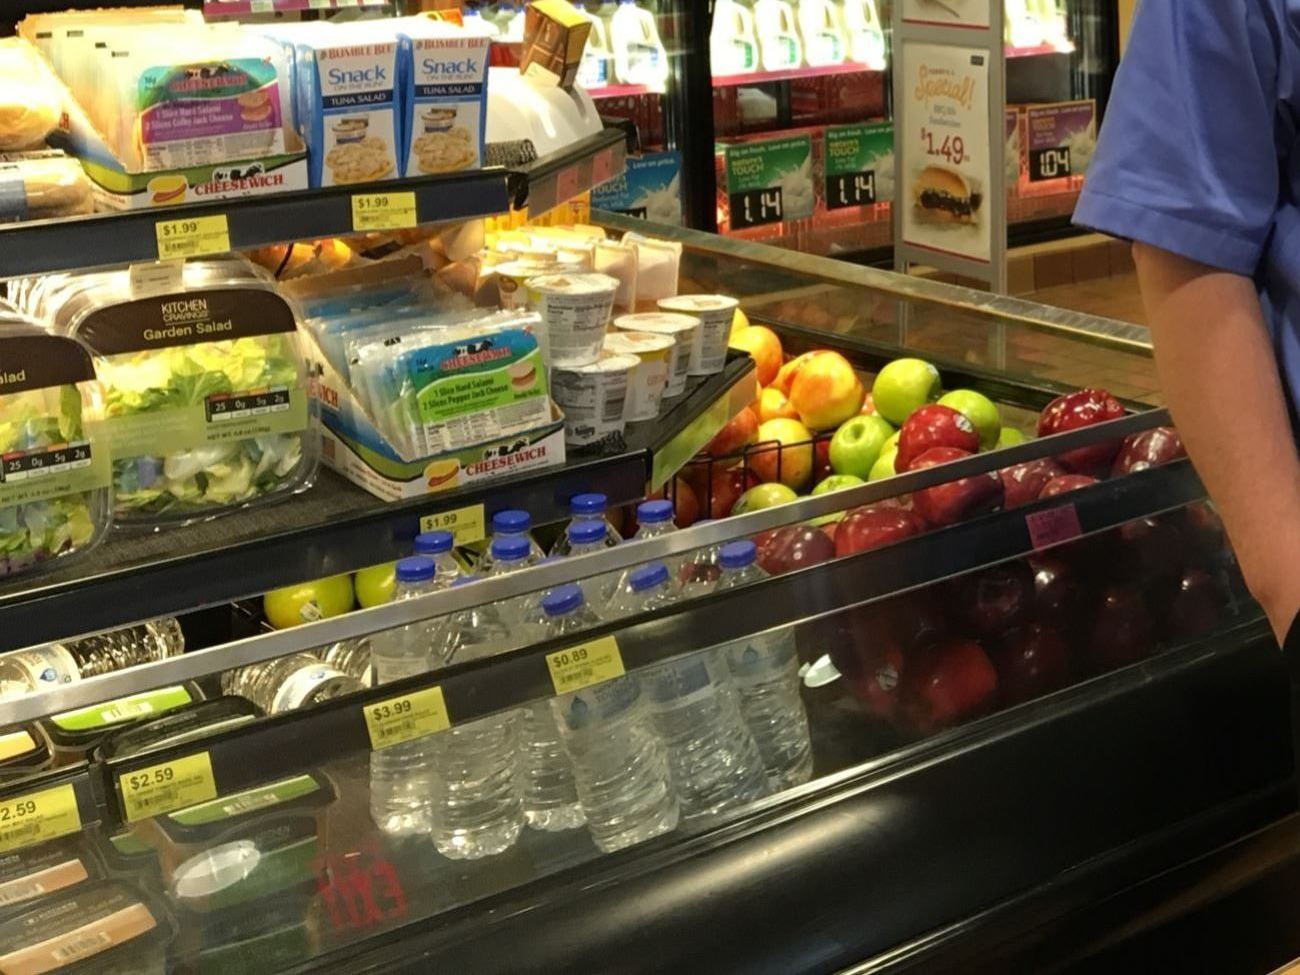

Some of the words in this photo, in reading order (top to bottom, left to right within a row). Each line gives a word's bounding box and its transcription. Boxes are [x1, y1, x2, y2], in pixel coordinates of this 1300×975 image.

[422, 58, 477, 75] Snack
[328, 65, 386, 85] Snack
[423, 86, 447, 95] TUNA
[448, 85, 475, 94] SALAD
[331, 95, 355, 106] TUNA
[357, 92, 386, 104] SALAD
[830, 146, 859, 157] TOUCH
[732, 163, 764, 175] TOUCH
[195, 174, 283, 196] CHEESEWICH
[358, 197, 388, 209] $1.99
[163, 222, 197, 236] $1.99
[161, 299, 207, 314] KITCHEN
[163, 310, 208, 322] CRAVINGS
[144, 326, 192, 341] Garden
[196, 320, 232, 334] Salad
[440, 346, 512, 370] CHEESEWICH
[215, 402, 226, 412] 25
[9, 461, 21, 471] 25
[31, 457, 43, 468] 0g
[55, 453, 66, 463] 5g
[75, 449, 86, 458] 2g
[466, 446, 546, 476] CHEESEWICH
[426, 513, 457, 529] $1.99
[552, 648, 588, 668] $0.89
[373, 700, 411, 721] $3.99
[130, 767, 174, 791] $2.59
